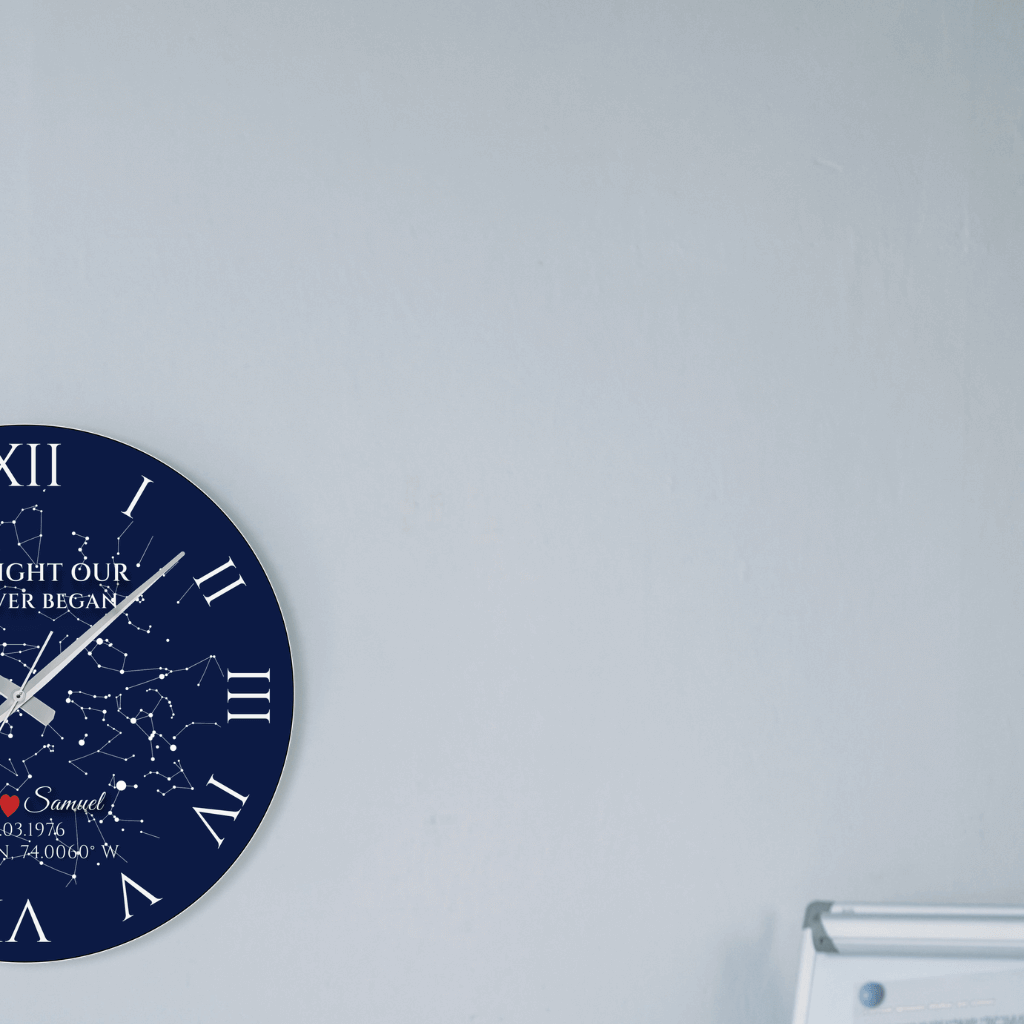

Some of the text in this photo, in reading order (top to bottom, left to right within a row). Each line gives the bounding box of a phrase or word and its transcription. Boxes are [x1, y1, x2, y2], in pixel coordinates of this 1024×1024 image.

[121, 475, 154, 519] I
[71, 562, 131, 582] OUR
[192, 555, 247, 607] II
[43, 592, 118, 609] BEGAN
[227, 668, 271, 724] III
[23, 785, 107, 814] Samuel
[192, 774, 250, 849] IV
[19, 844, 95, 860] 74.0060°
[101, 844, 120, 859] W
[120, 872, 163, 922] V
